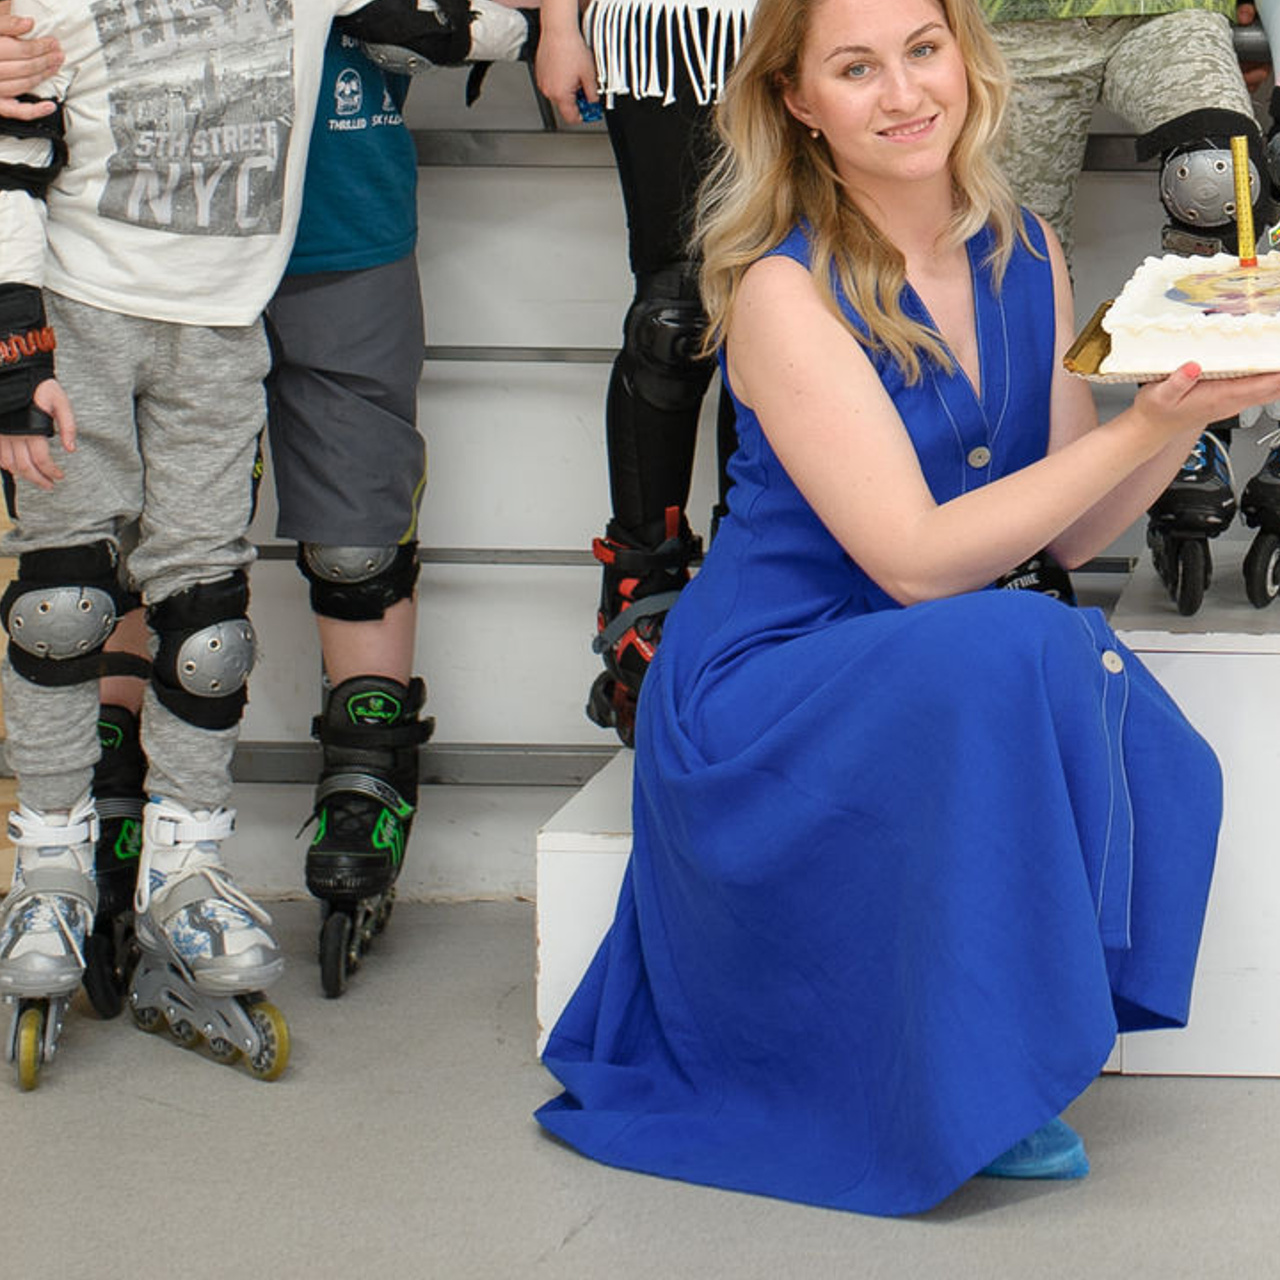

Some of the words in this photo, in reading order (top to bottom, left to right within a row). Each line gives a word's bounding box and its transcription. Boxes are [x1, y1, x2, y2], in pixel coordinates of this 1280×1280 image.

[134, 130, 191, 156] 5TH
[191, 121, 278, 157] STREET
[127, 155, 278, 229] NYC
